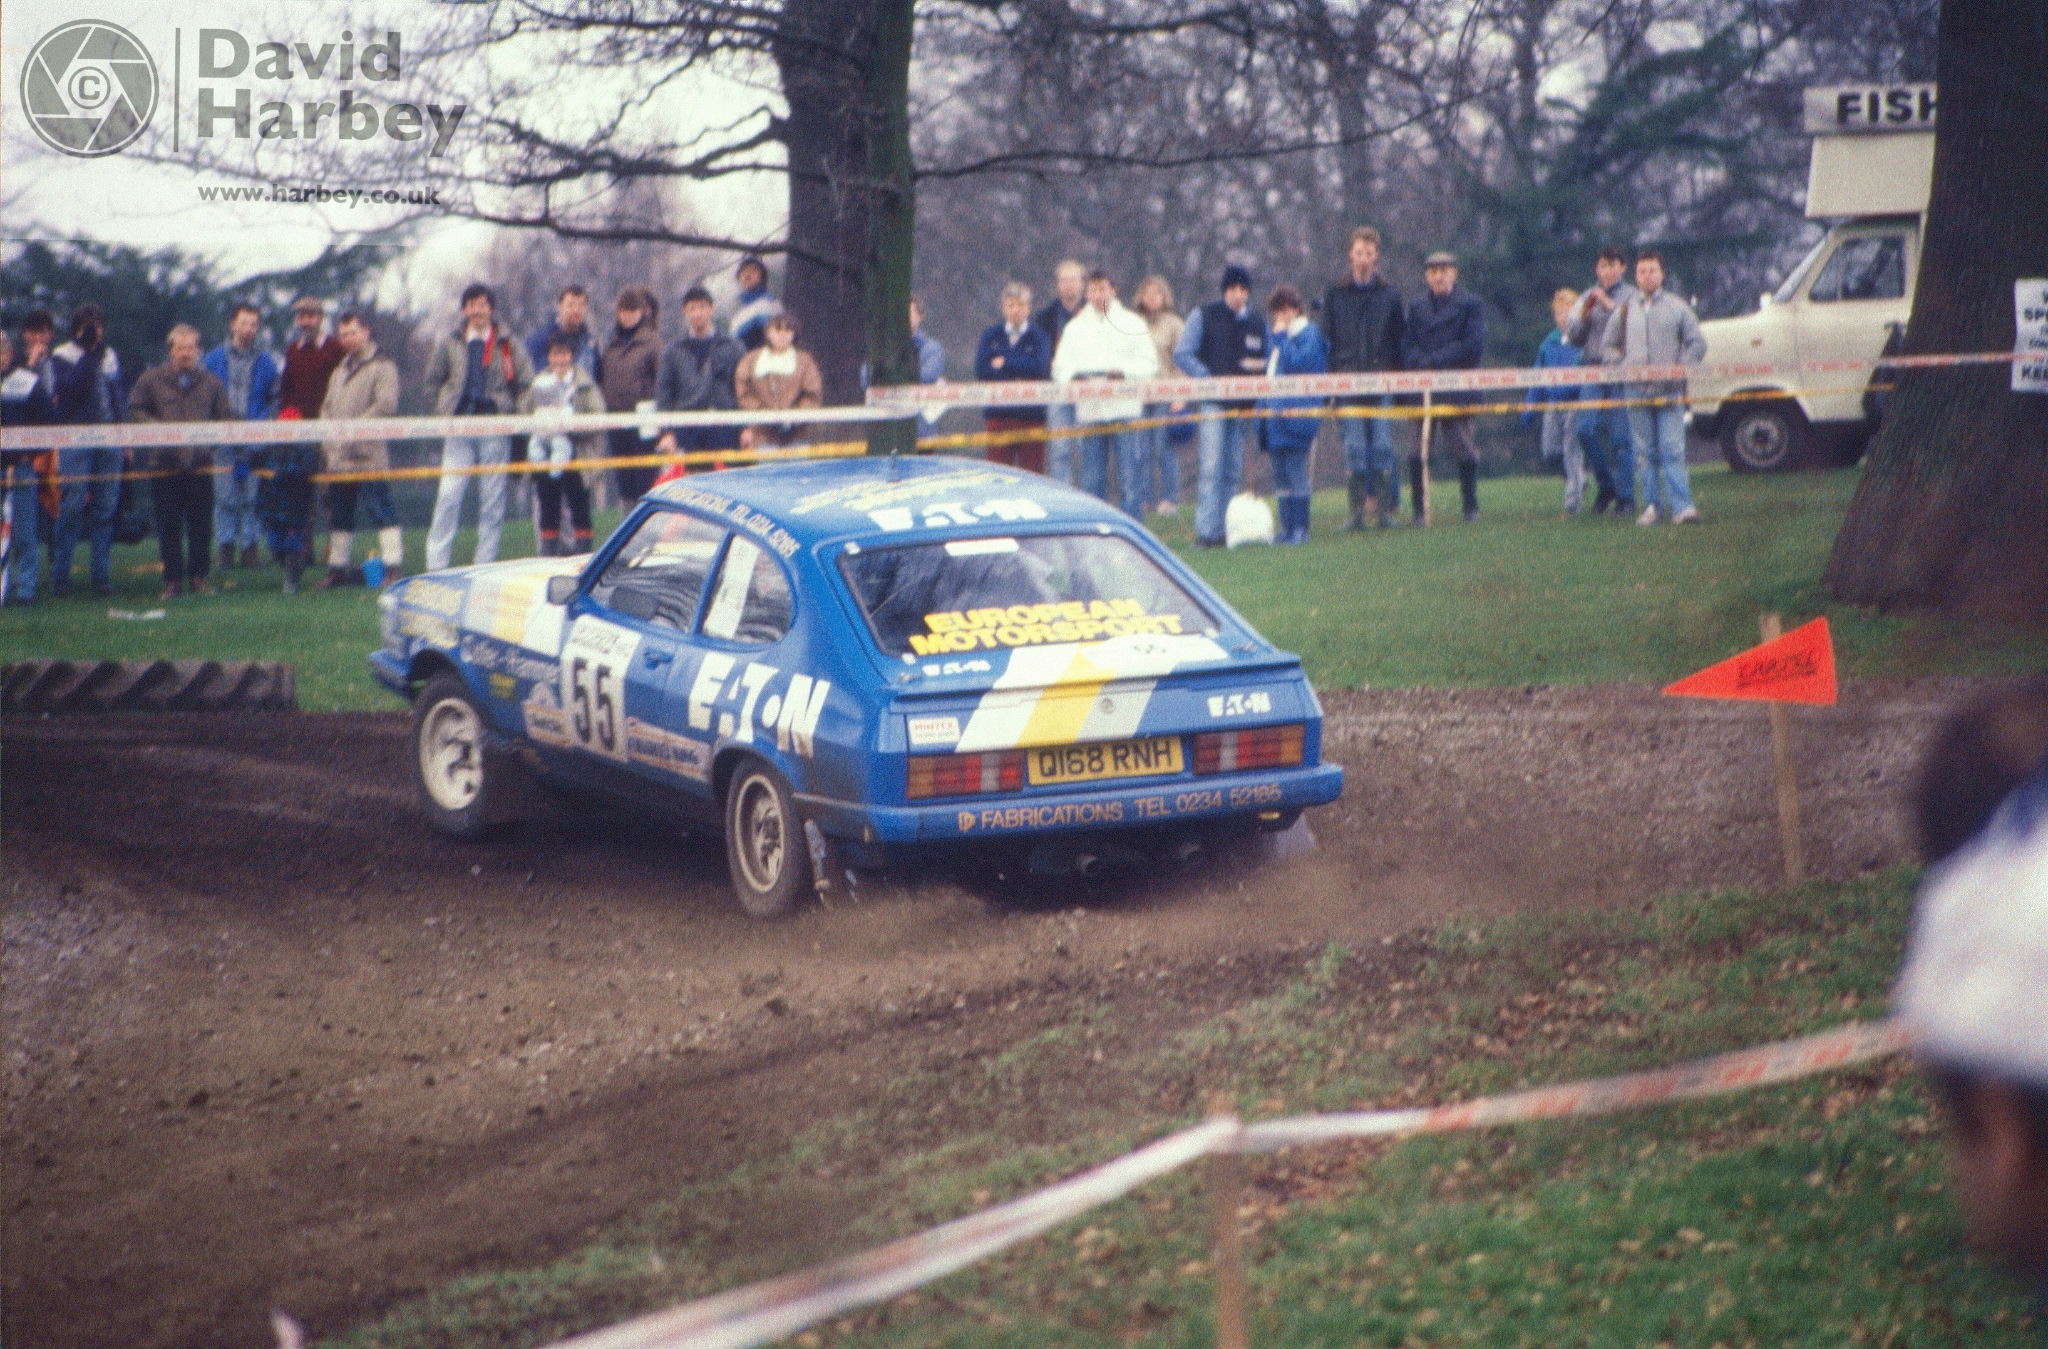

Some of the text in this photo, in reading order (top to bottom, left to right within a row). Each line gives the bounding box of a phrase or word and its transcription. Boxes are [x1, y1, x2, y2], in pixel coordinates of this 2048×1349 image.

[908, 614, 1183, 656] MOTORSPORT
[924, 598, 1146, 634] EUROPEAN
[573, 656, 615, 751] 55
[1039, 742, 1174, 779] Q168 RNH
[981, 801, 1123, 830] FABRICATIONS
[1134, 796, 1172, 817] TEL
[1176, 790, 1223, 813] 0234
